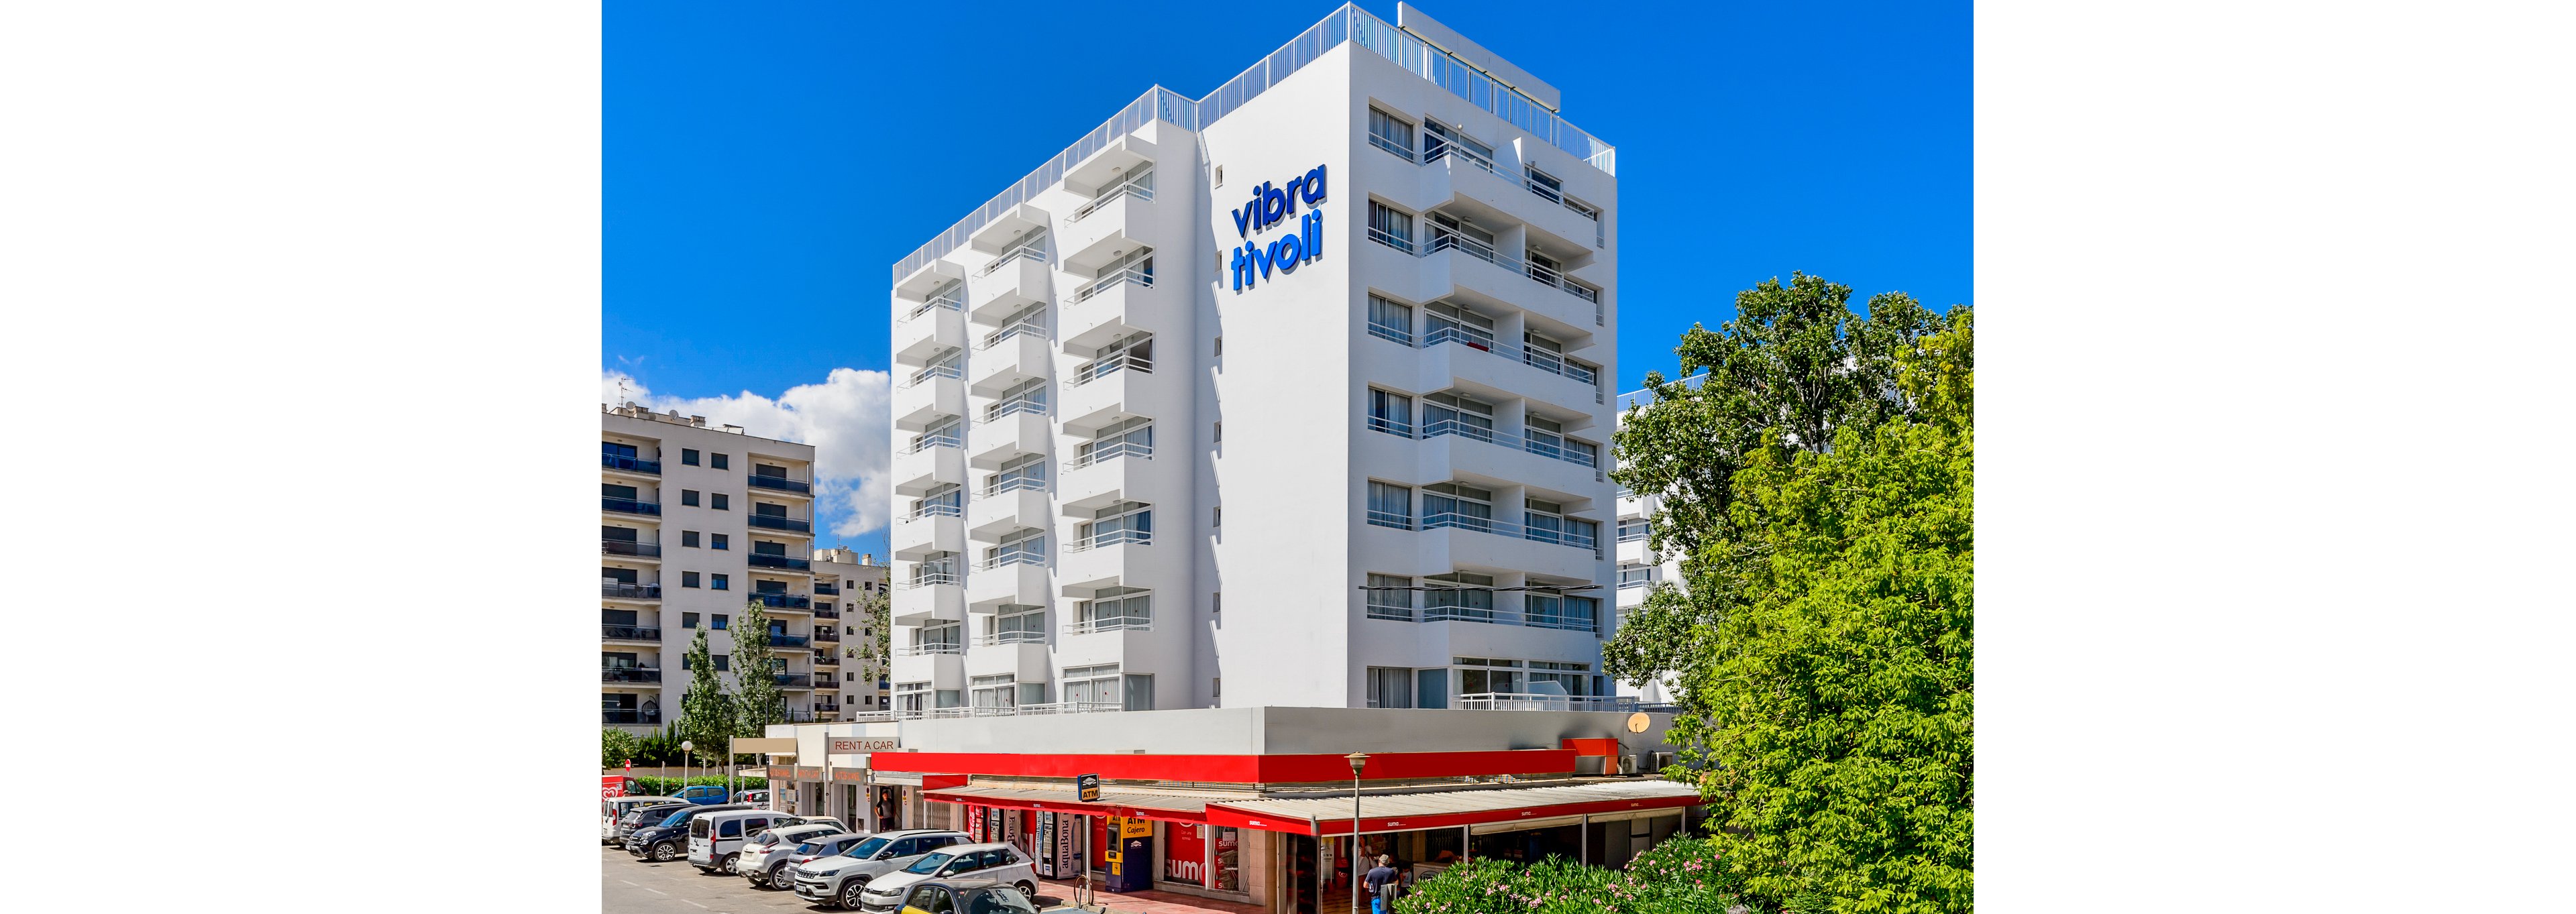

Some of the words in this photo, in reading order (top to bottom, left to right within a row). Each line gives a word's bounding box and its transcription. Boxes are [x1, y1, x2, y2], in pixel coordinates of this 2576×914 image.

[1232, 164, 1326, 239] vibra
[1231, 209, 1323, 291] tivoli
[835, 741, 862, 750] RENT
[864, 741, 871, 750] A
[873, 740, 894, 750] CAR
[1083, 790, 1098, 799] ATM
[1061, 819, 1070, 869] aquaBona
[1127, 826, 1145, 834] Cajero
